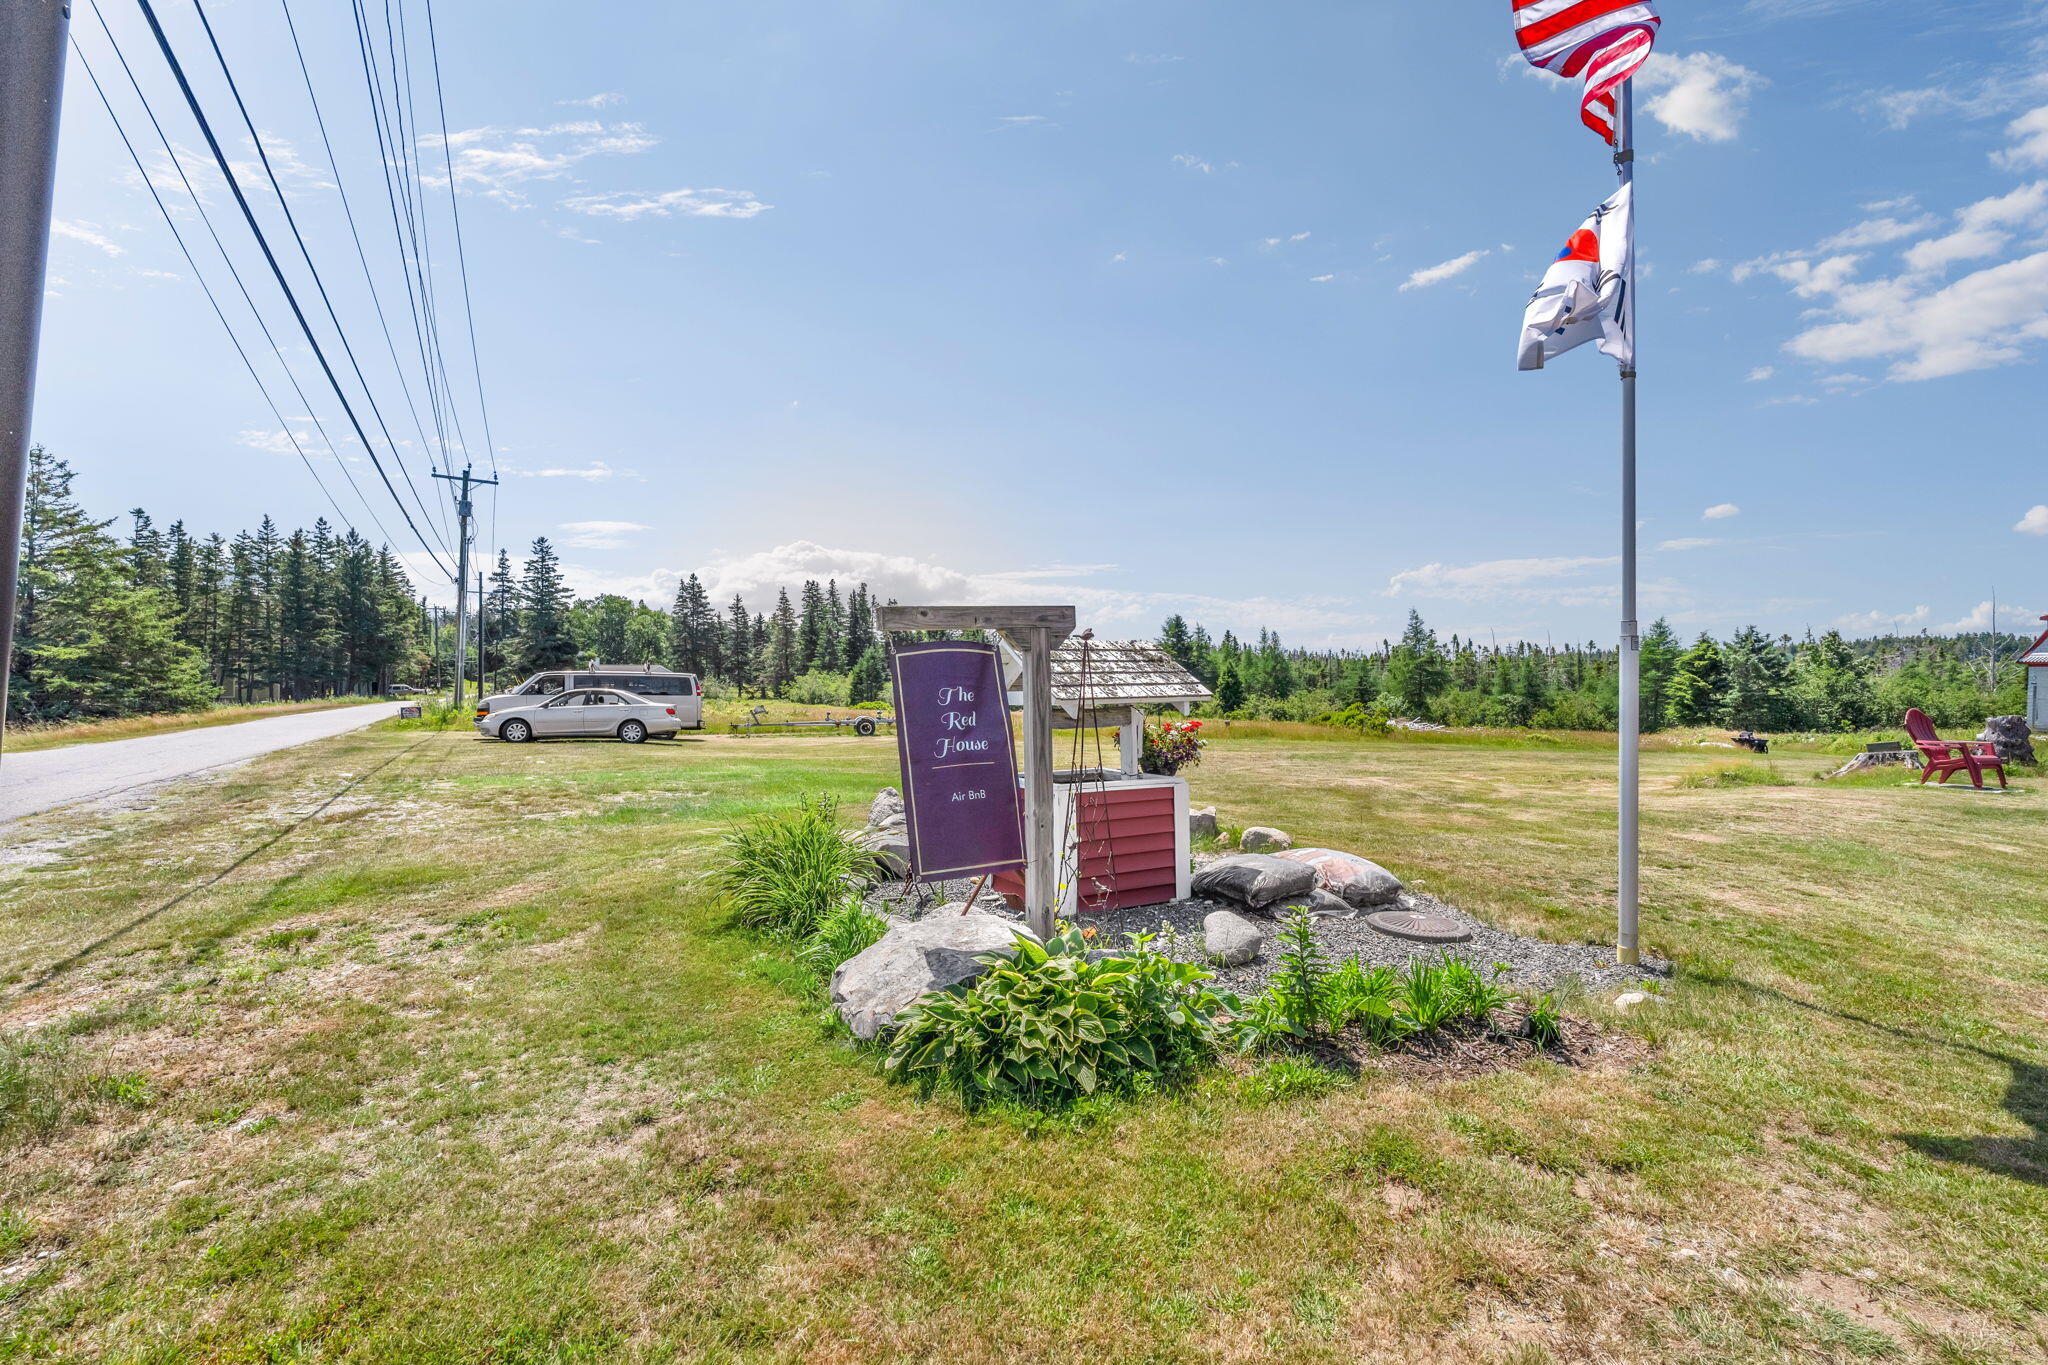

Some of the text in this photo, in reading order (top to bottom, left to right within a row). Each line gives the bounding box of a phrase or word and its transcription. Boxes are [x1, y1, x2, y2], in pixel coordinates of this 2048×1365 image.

[937, 686, 975, 706] The
[940, 711, 976, 731] Red
[933, 736, 989, 759] House
[951, 789, 986, 802] Air BnB
